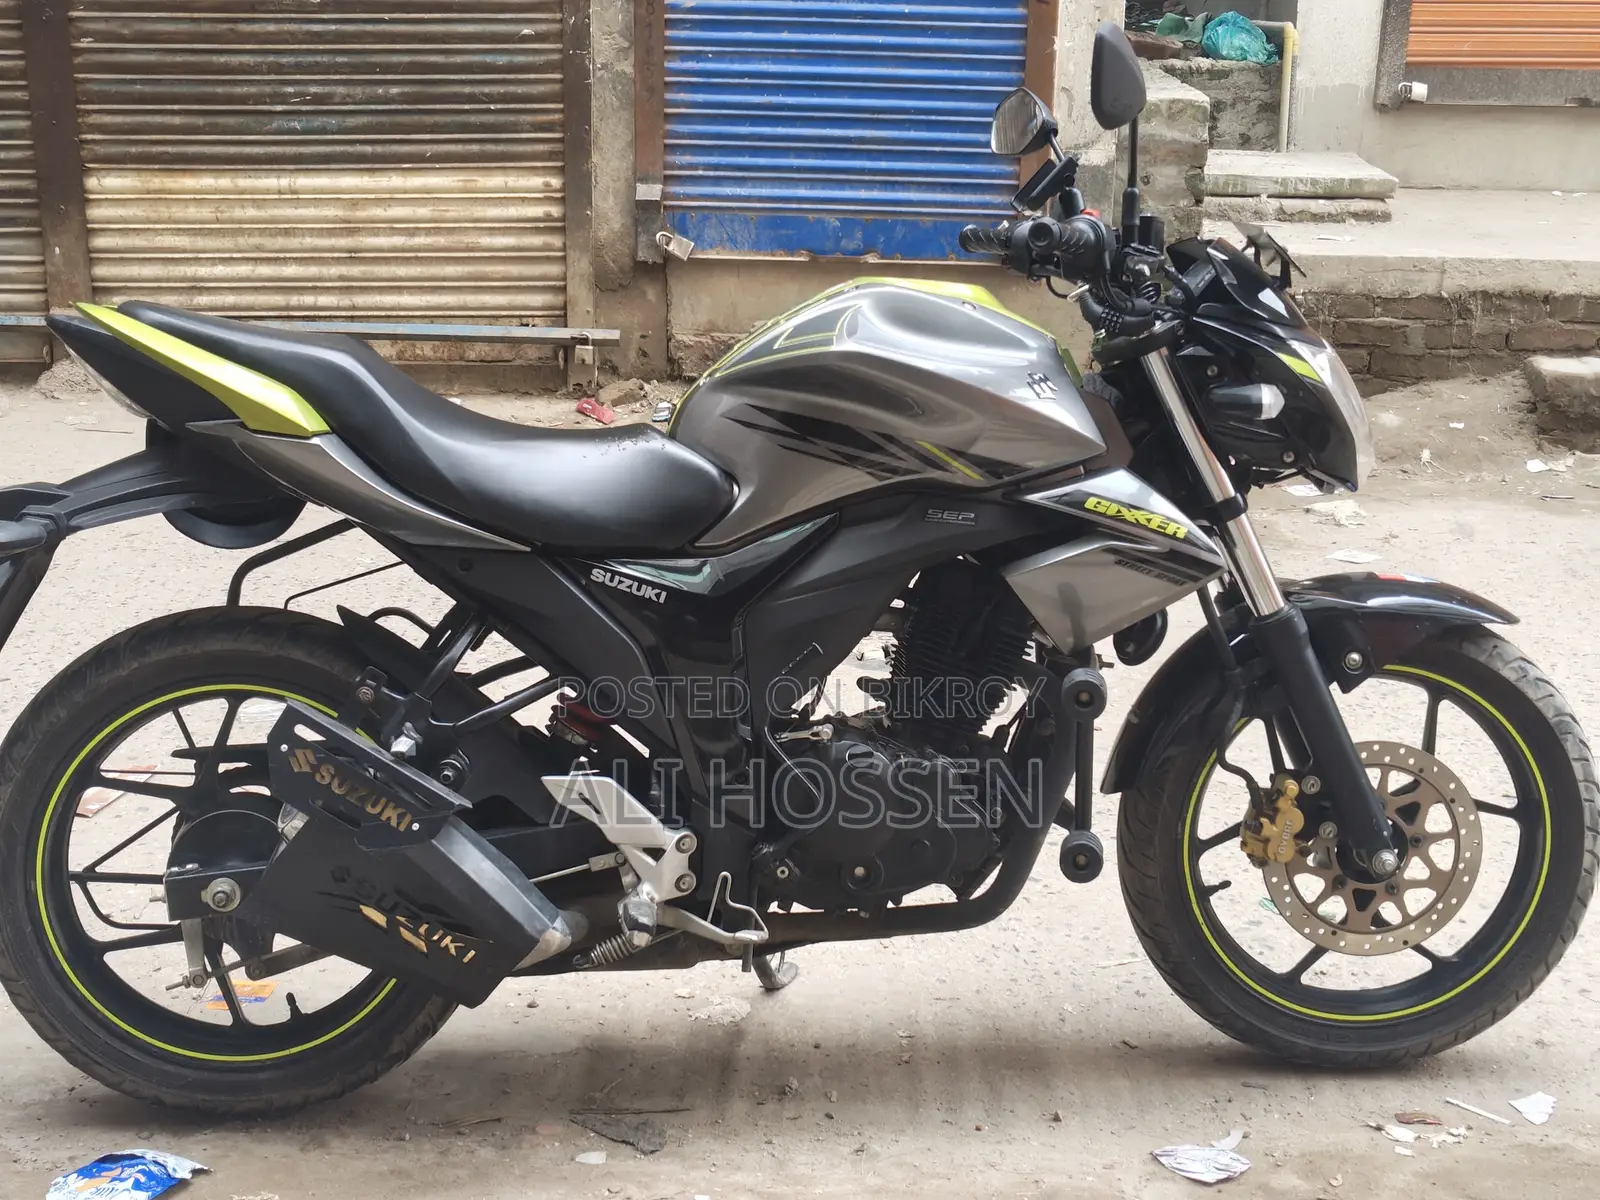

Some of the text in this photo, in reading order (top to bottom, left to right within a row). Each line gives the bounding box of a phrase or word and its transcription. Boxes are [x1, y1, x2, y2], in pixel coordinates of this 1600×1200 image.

[926, 509, 975, 520] SEP
[1084, 497, 1188, 539] GIXXER
[590, 568, 667, 604] SUZUKI
[315, 763, 413, 832] SUZUKI
